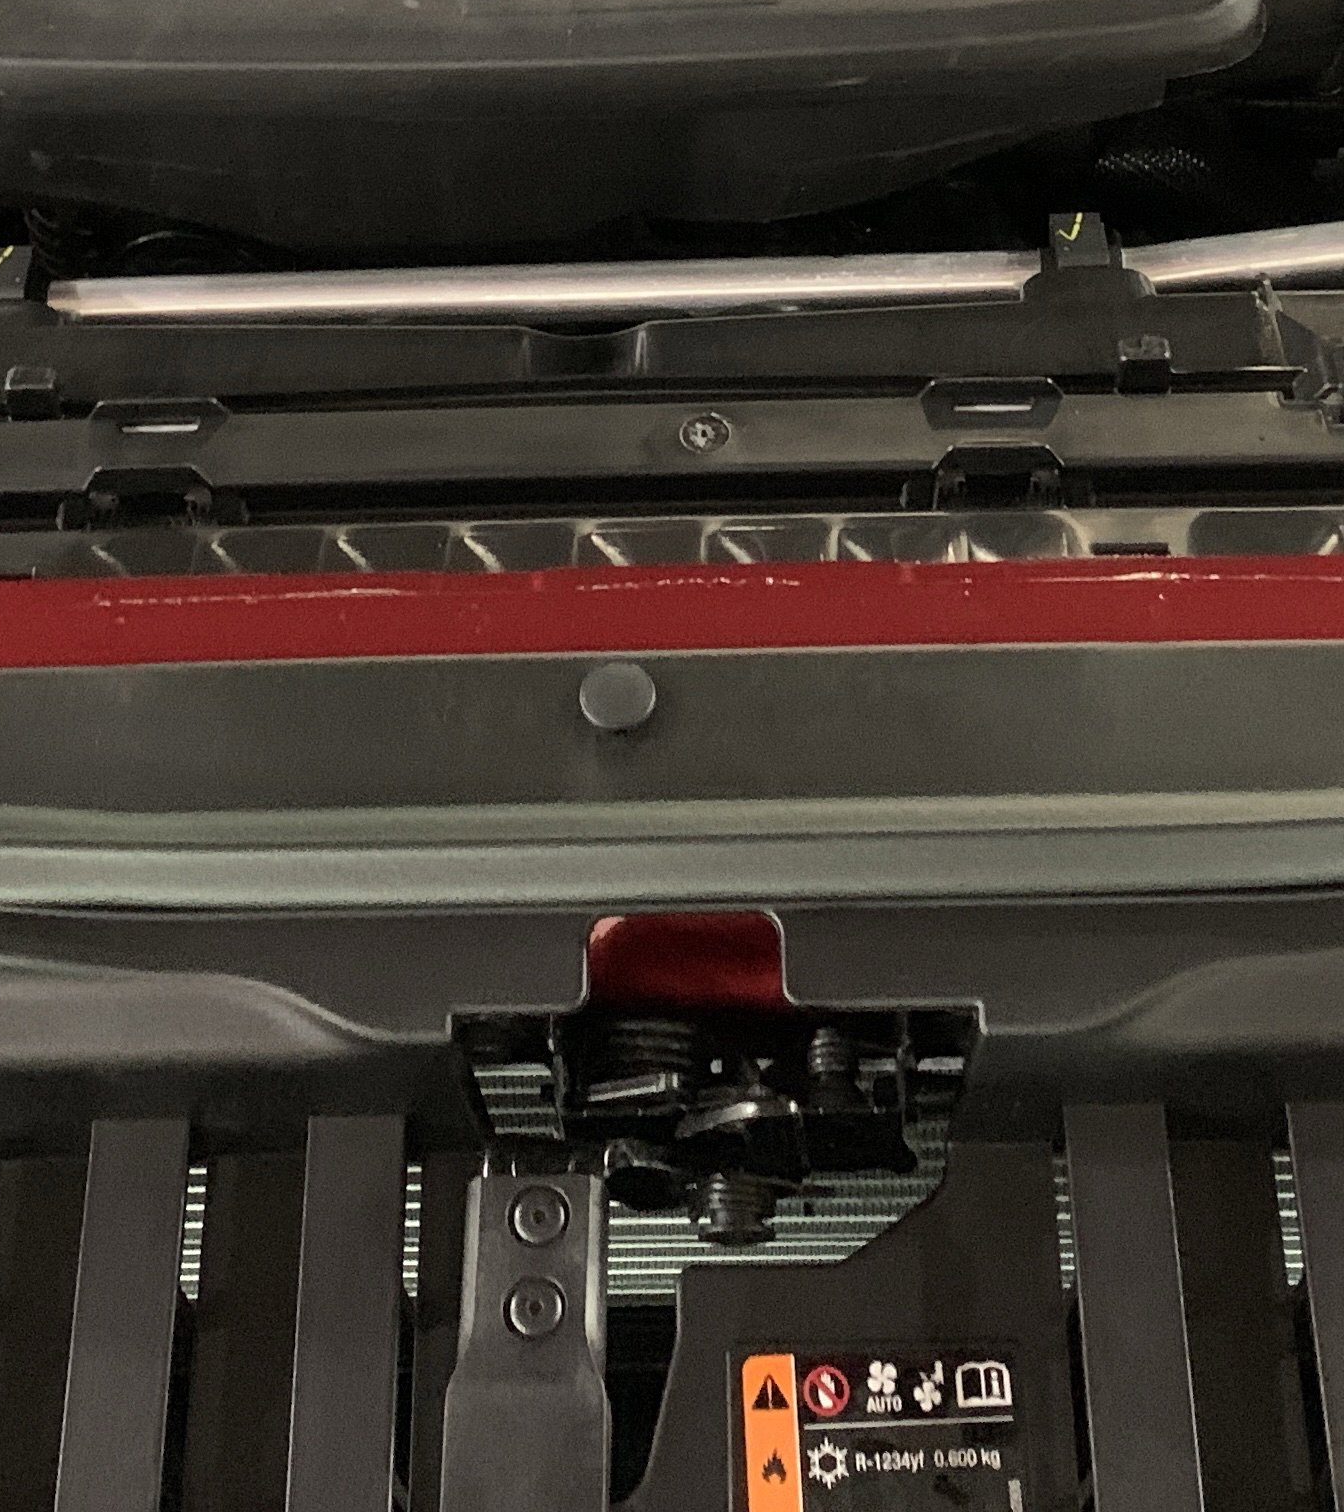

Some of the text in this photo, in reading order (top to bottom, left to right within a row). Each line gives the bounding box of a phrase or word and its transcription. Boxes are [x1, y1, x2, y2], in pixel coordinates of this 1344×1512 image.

[866, 1395, 903, 1414] AUTO
[855, 1448, 925, 1473] R-1234yf
[980, 1447, 1002, 1471] kg
